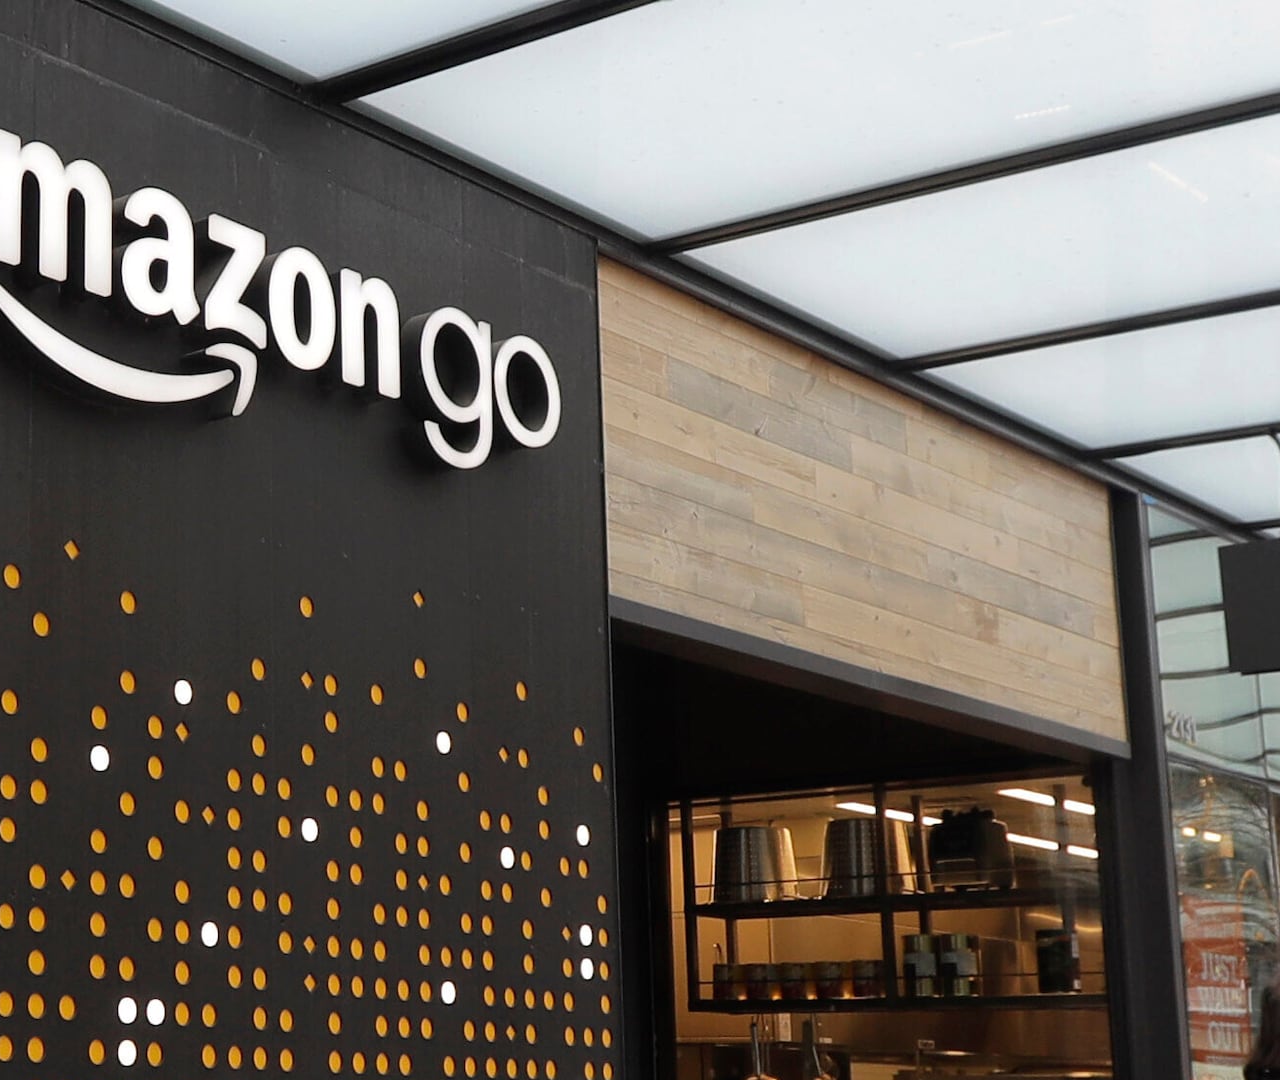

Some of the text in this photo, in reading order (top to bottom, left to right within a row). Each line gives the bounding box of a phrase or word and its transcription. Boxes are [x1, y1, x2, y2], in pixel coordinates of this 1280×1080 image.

[420, 306, 562, 470] go
[1201, 951, 1240, 985] JUST
[1207, 1020, 1241, 1050] OUT
